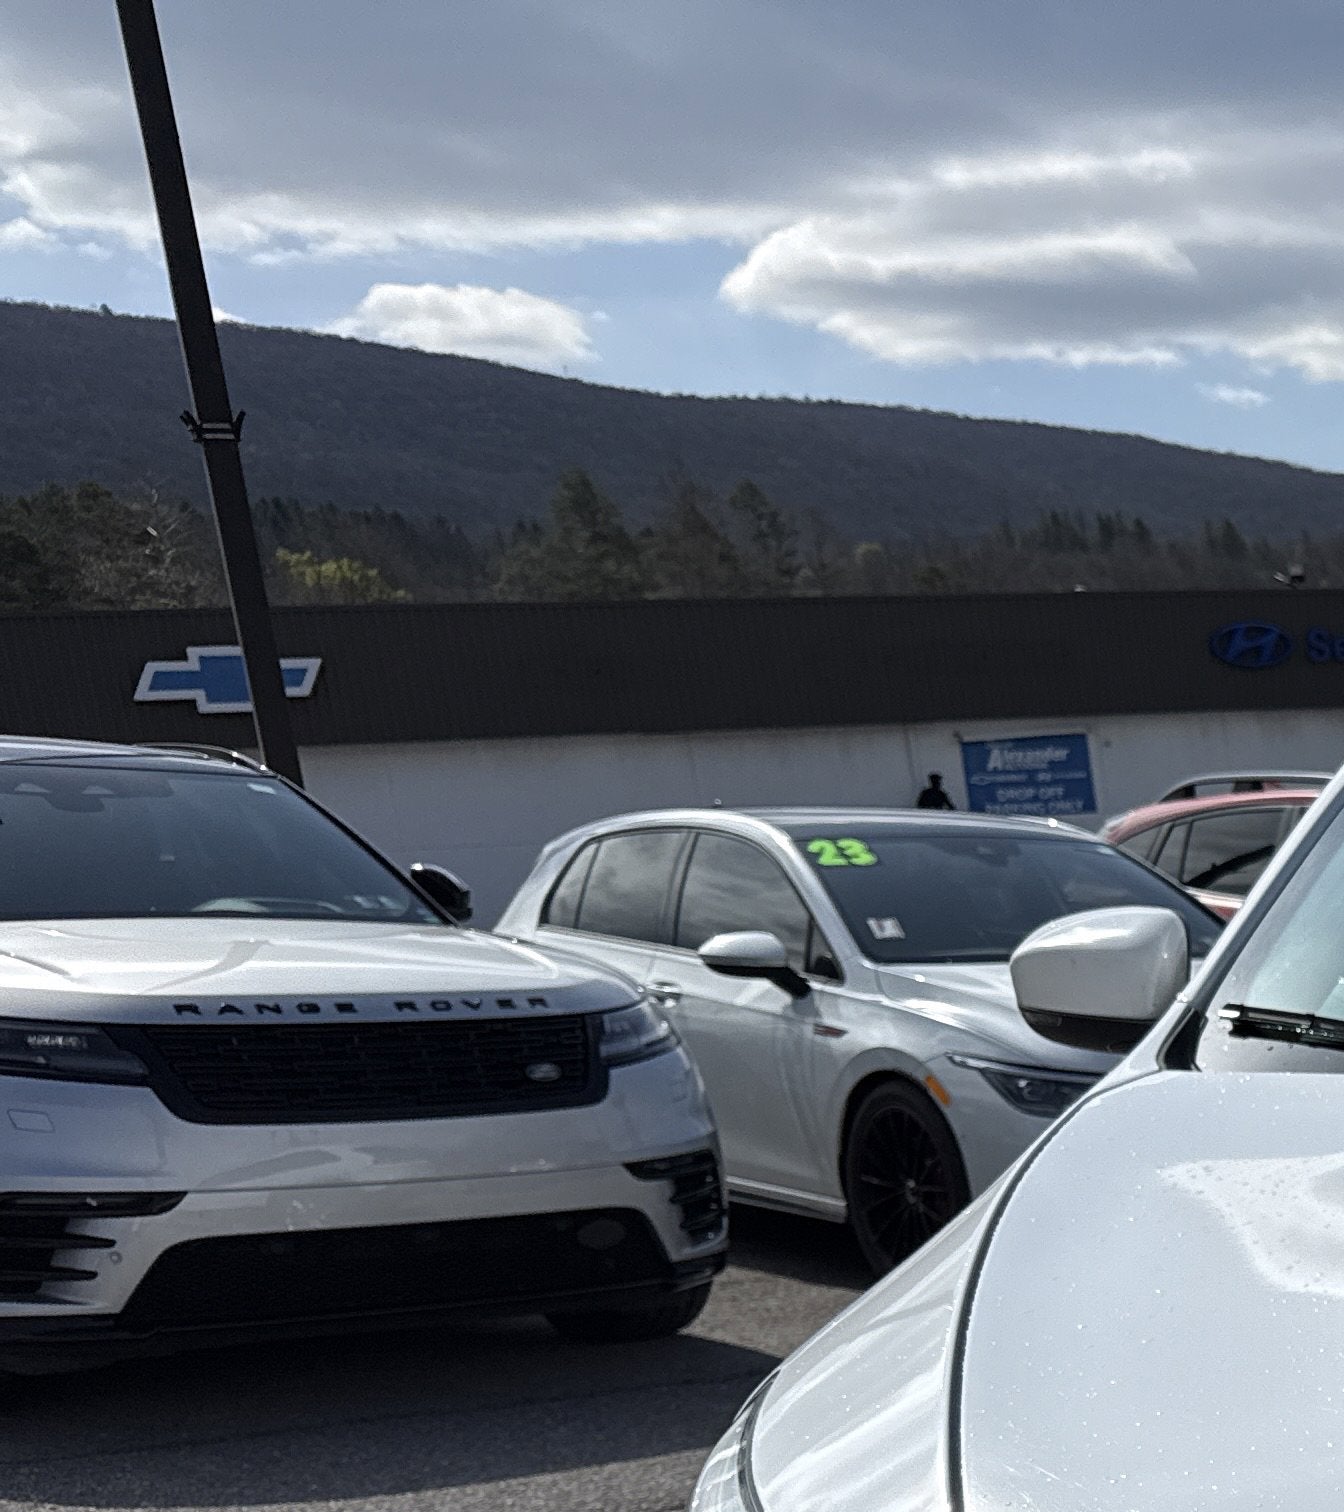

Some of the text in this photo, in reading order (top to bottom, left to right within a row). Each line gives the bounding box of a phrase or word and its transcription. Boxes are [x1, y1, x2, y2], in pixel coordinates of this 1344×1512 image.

[806, 838, 878, 866] 23
[173, 997, 550, 1017] RANGE ROVER
